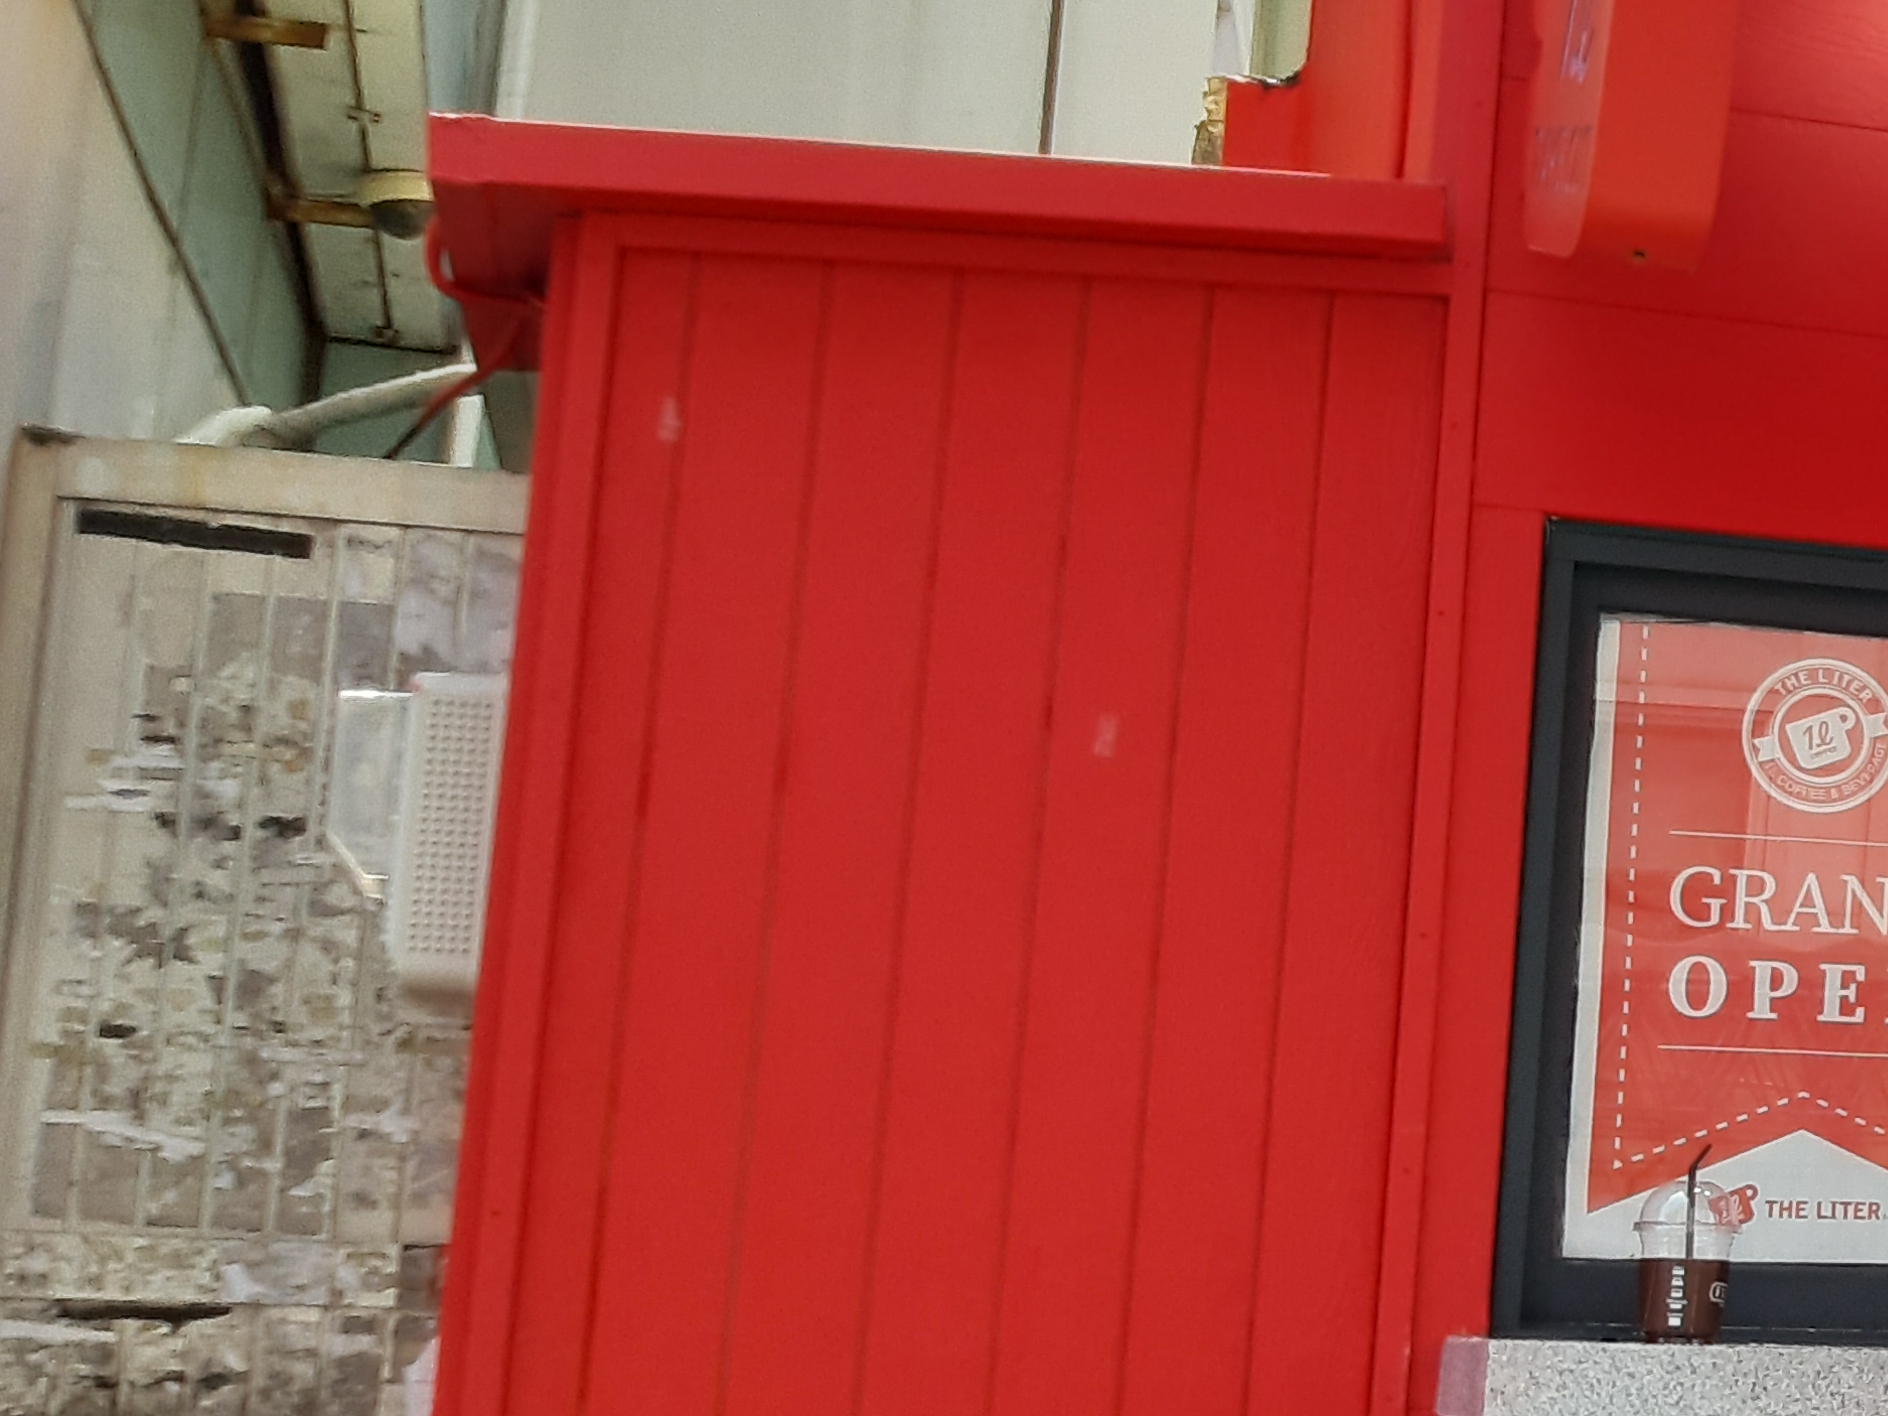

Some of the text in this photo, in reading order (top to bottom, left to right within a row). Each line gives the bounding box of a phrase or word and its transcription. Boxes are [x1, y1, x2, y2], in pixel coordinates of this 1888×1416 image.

[1773, 668, 1874, 704] THE LITER
[1764, 1199, 1883, 1222] THE LITER
